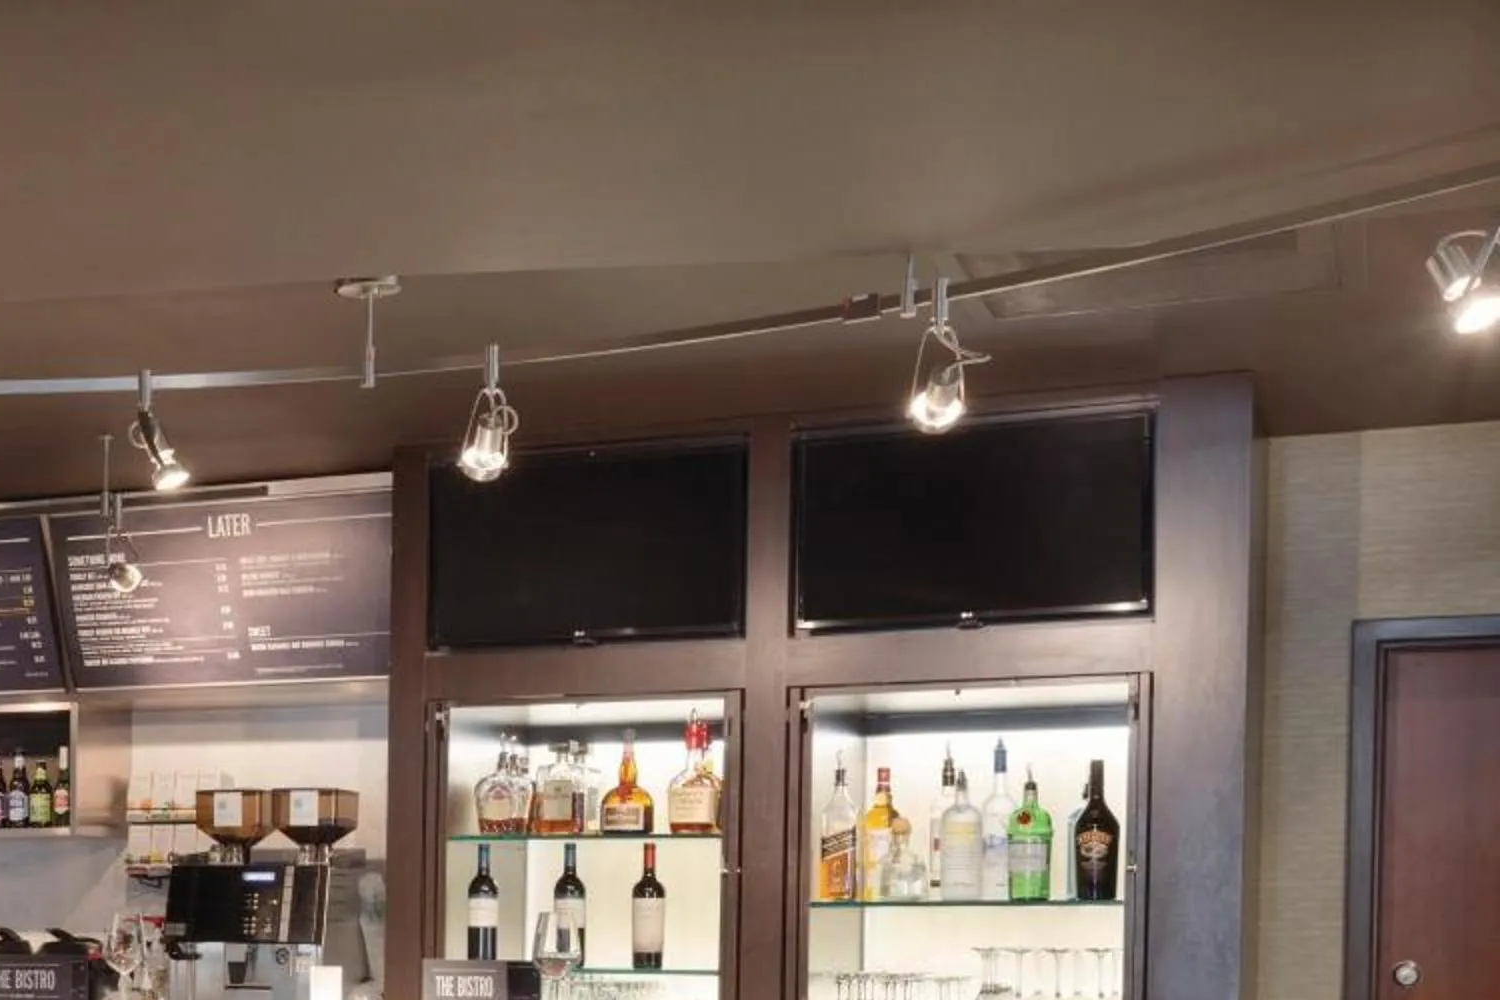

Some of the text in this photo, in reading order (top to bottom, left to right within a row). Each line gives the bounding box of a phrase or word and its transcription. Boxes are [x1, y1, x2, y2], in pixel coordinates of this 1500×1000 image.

[207, 513, 251, 538] LATER
[15, 969, 56, 990] BISTRO
[435, 976, 494, 998] THE BISTRO
